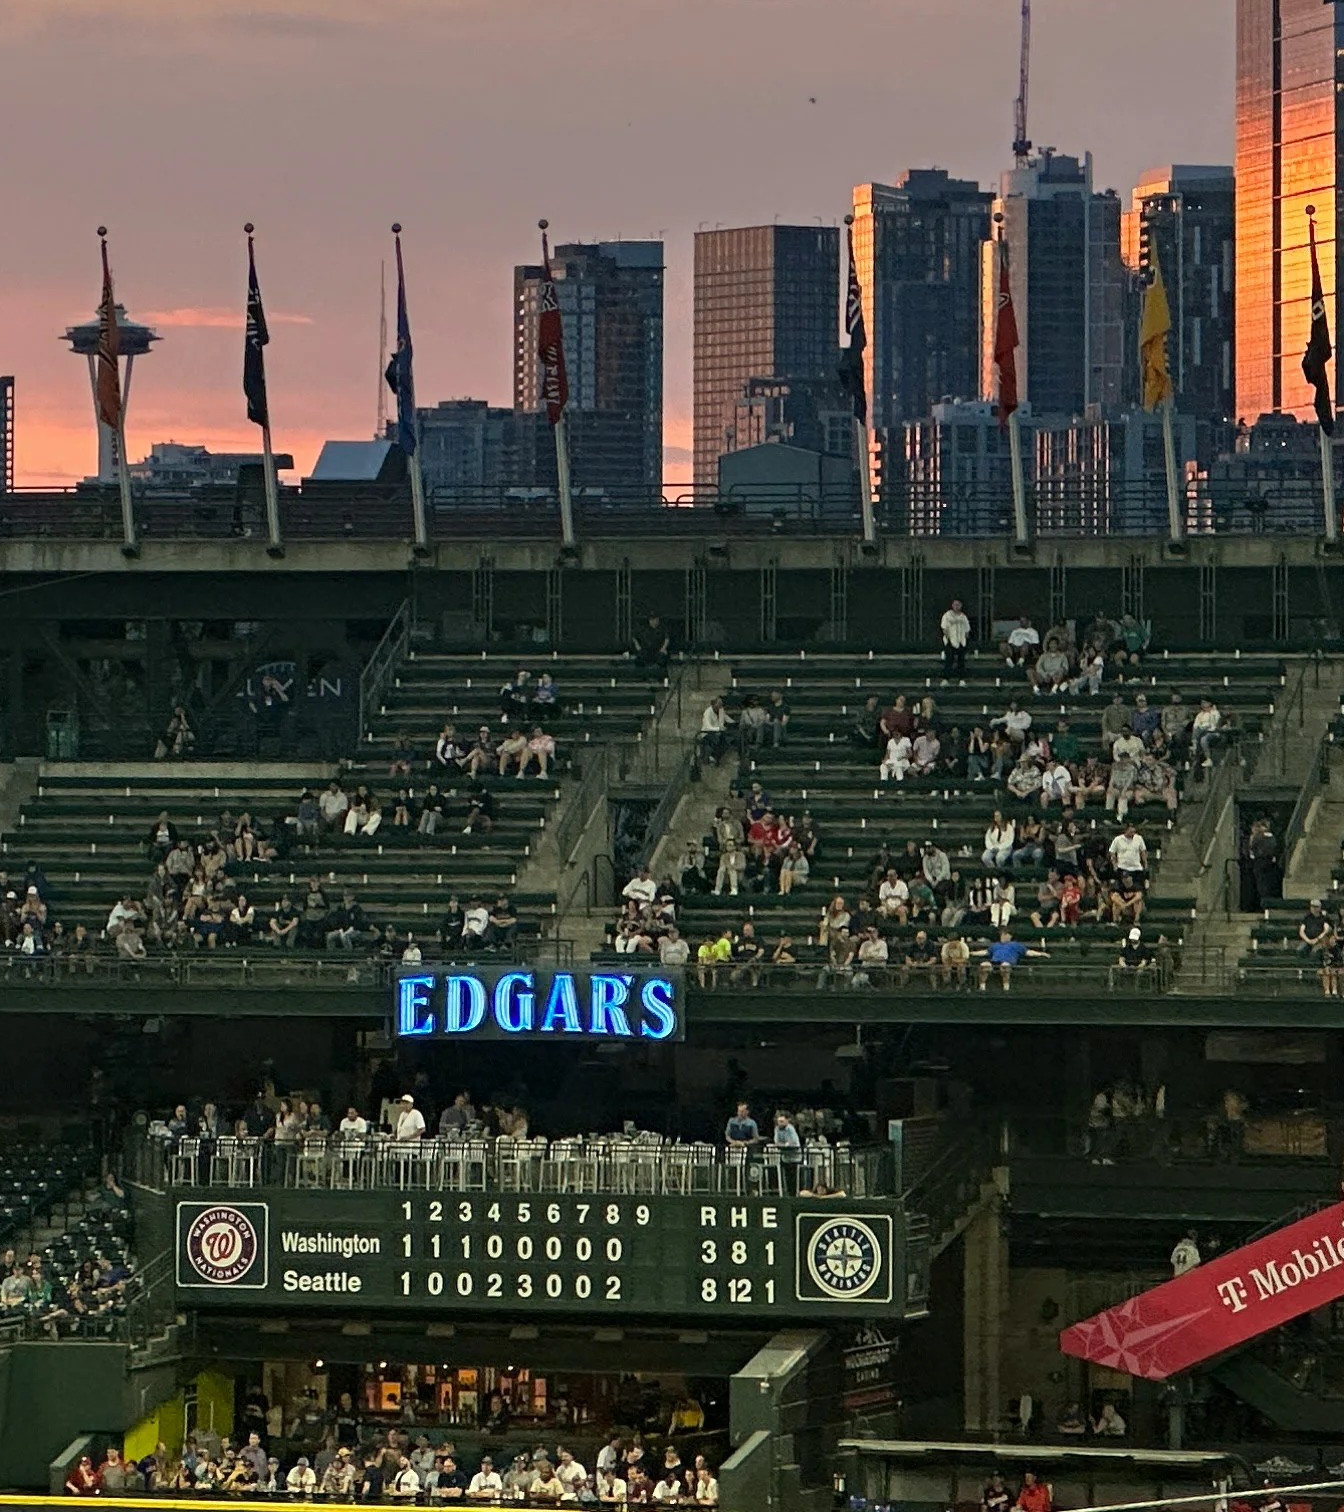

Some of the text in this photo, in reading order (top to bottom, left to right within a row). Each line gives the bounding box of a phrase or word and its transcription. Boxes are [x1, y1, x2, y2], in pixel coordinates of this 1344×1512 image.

[193, 1211, 250, 1239] WASHINGTON
[402, 1201, 777, 1228] 1 2 3 4 5 6 7 8 9 R H E
[282, 1232, 774, 1265] Washington 1 1 1 0 0 0 0 0 3 8 1
[195, 1257, 249, 1278] NATIONALS
[283, 1270, 774, 1303] Seattle 1 0 0 2 3 0 0 2 8 12 1
